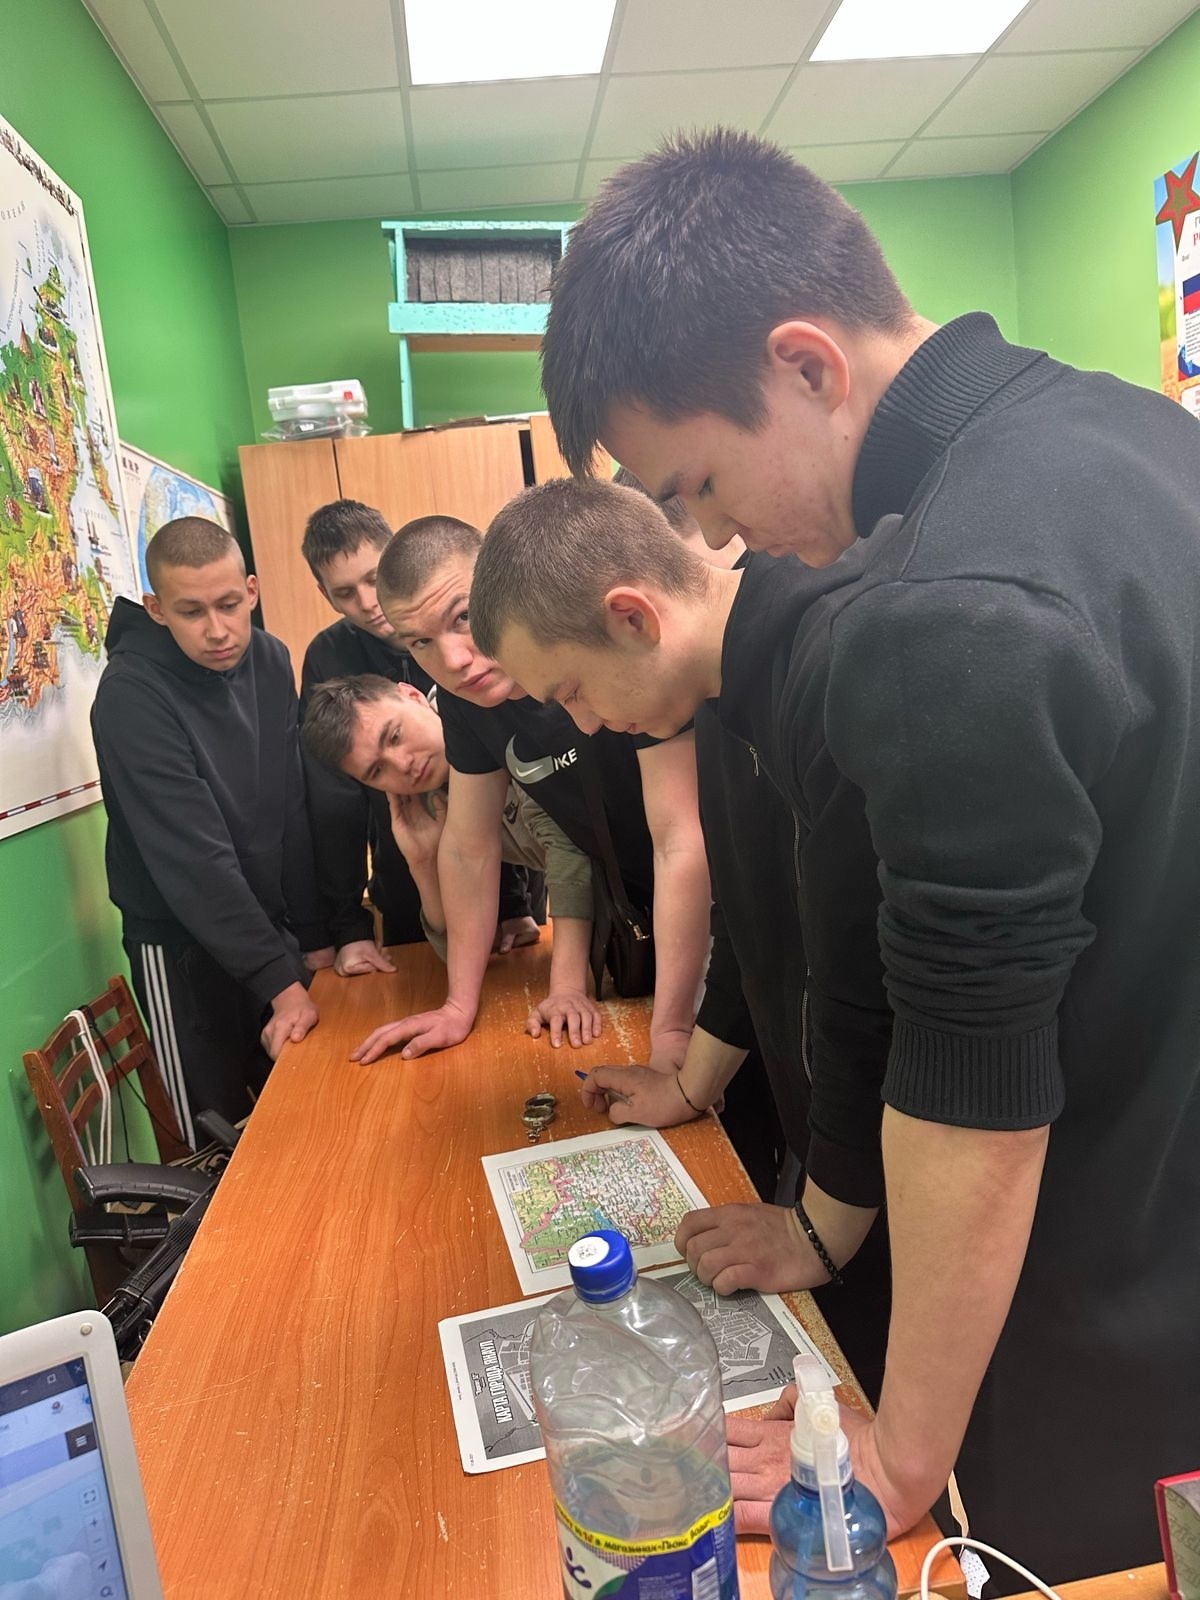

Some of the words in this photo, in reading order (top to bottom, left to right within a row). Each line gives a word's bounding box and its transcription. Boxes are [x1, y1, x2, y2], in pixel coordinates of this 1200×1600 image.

[553, 747, 578, 771] IKE
[479, 1339, 499, 1366] ЯНАУЛ
[485, 1364, 506, 1397] ГОРОДА
[492, 1395, 513, 1424] КАРТА
